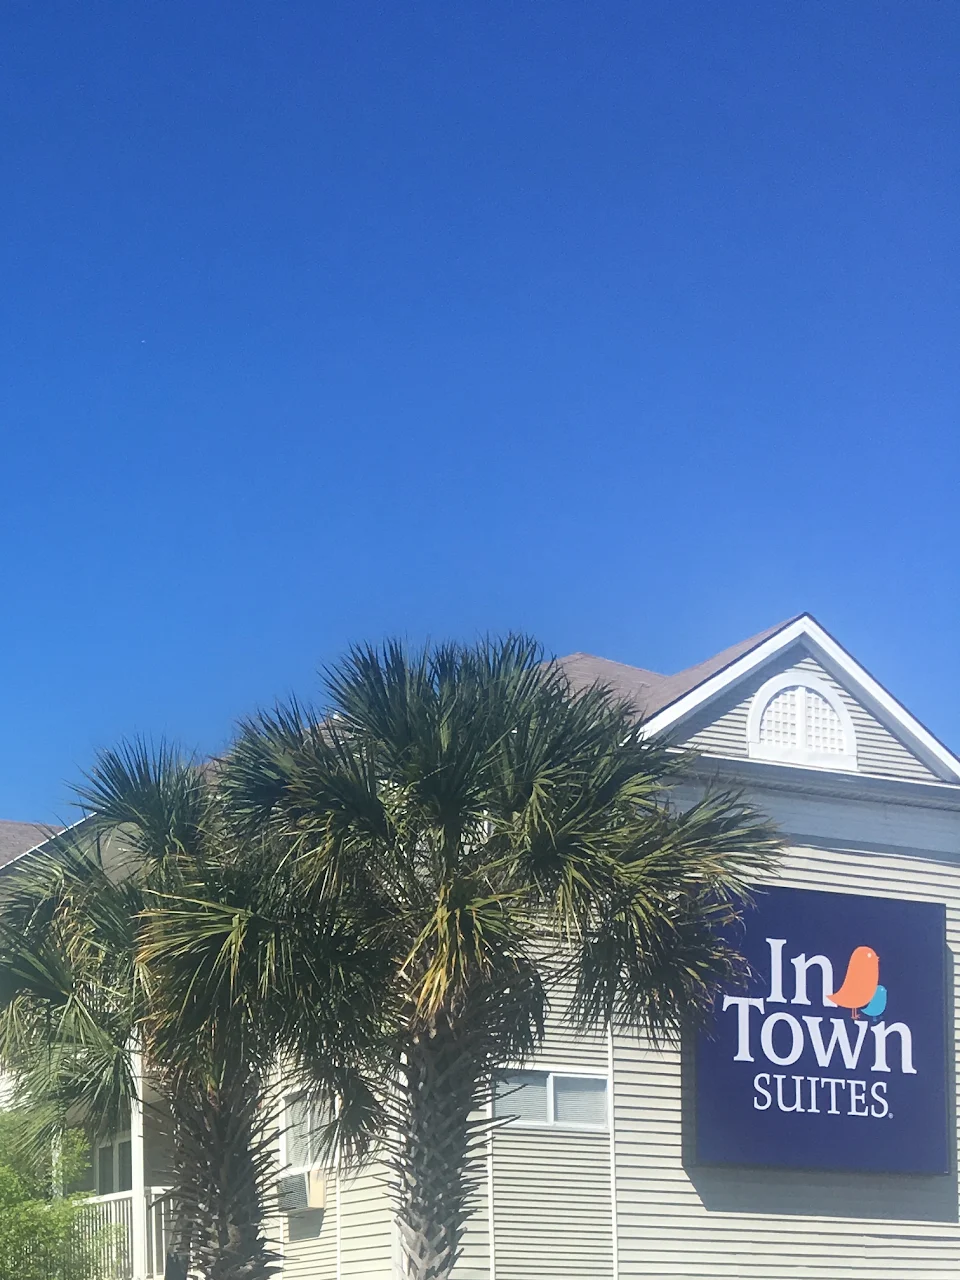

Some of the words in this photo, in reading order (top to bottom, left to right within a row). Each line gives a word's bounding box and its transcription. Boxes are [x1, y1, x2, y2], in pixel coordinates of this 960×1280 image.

[765, 937, 838, 1007] In
[722, 994, 917, 1074] Town
[753, 1072, 889, 1118] SUITES
